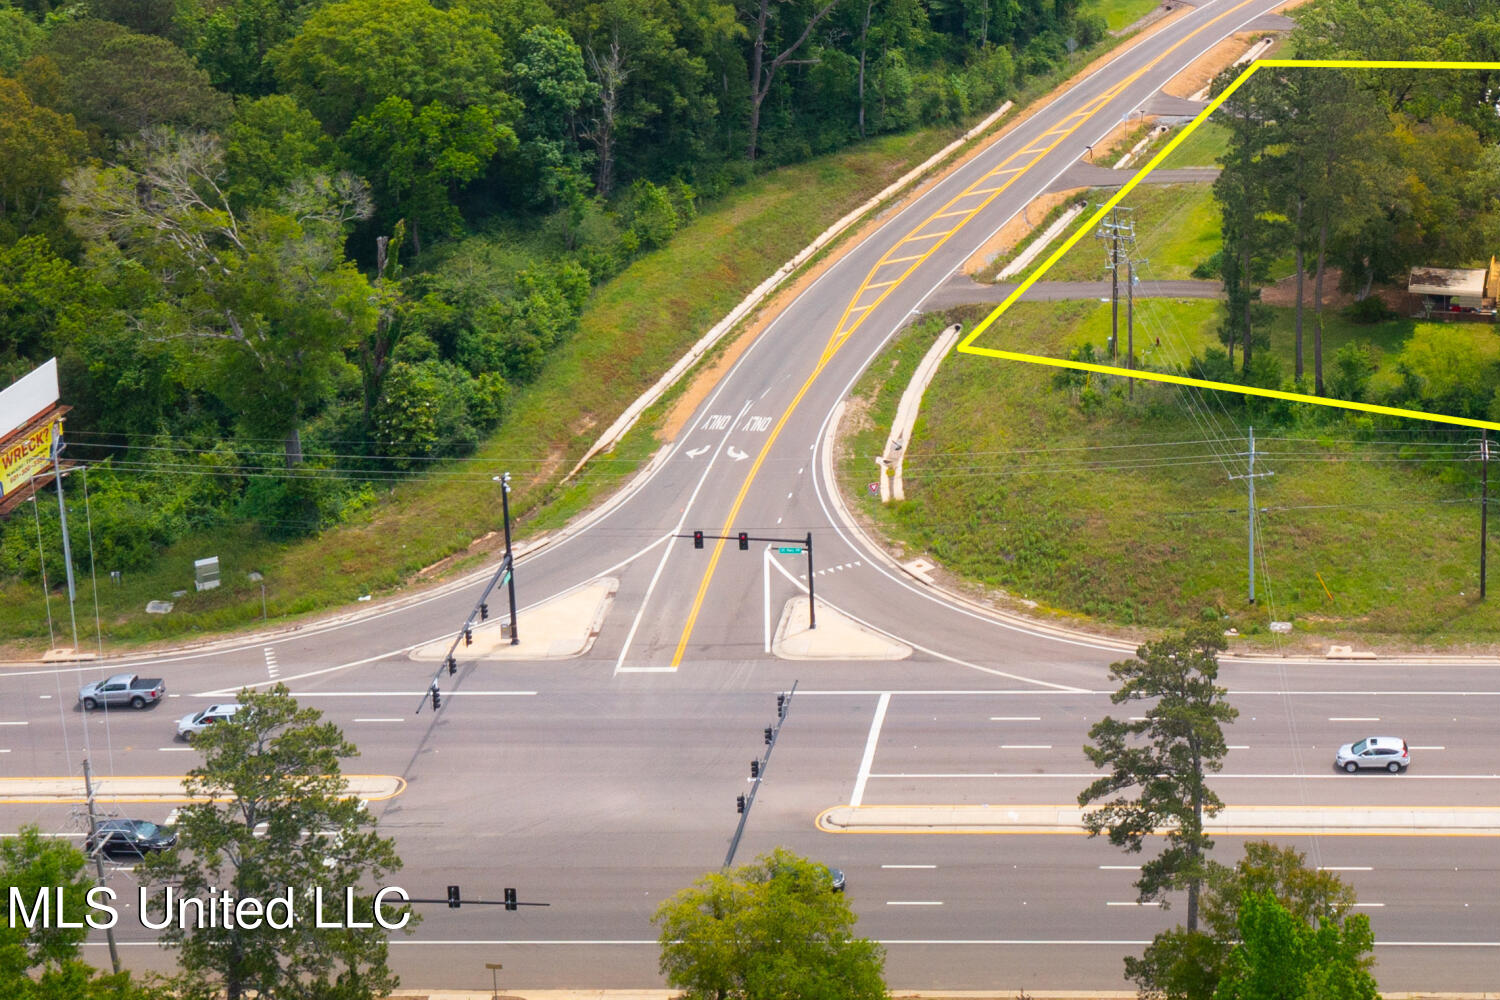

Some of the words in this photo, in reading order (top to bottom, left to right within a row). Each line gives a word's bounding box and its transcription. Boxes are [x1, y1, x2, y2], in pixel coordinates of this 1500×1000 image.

[700, 414, 731, 430] ONLY
[742, 415, 772, 431] ONLY
[2, 427, 49, 470] WRECK?
